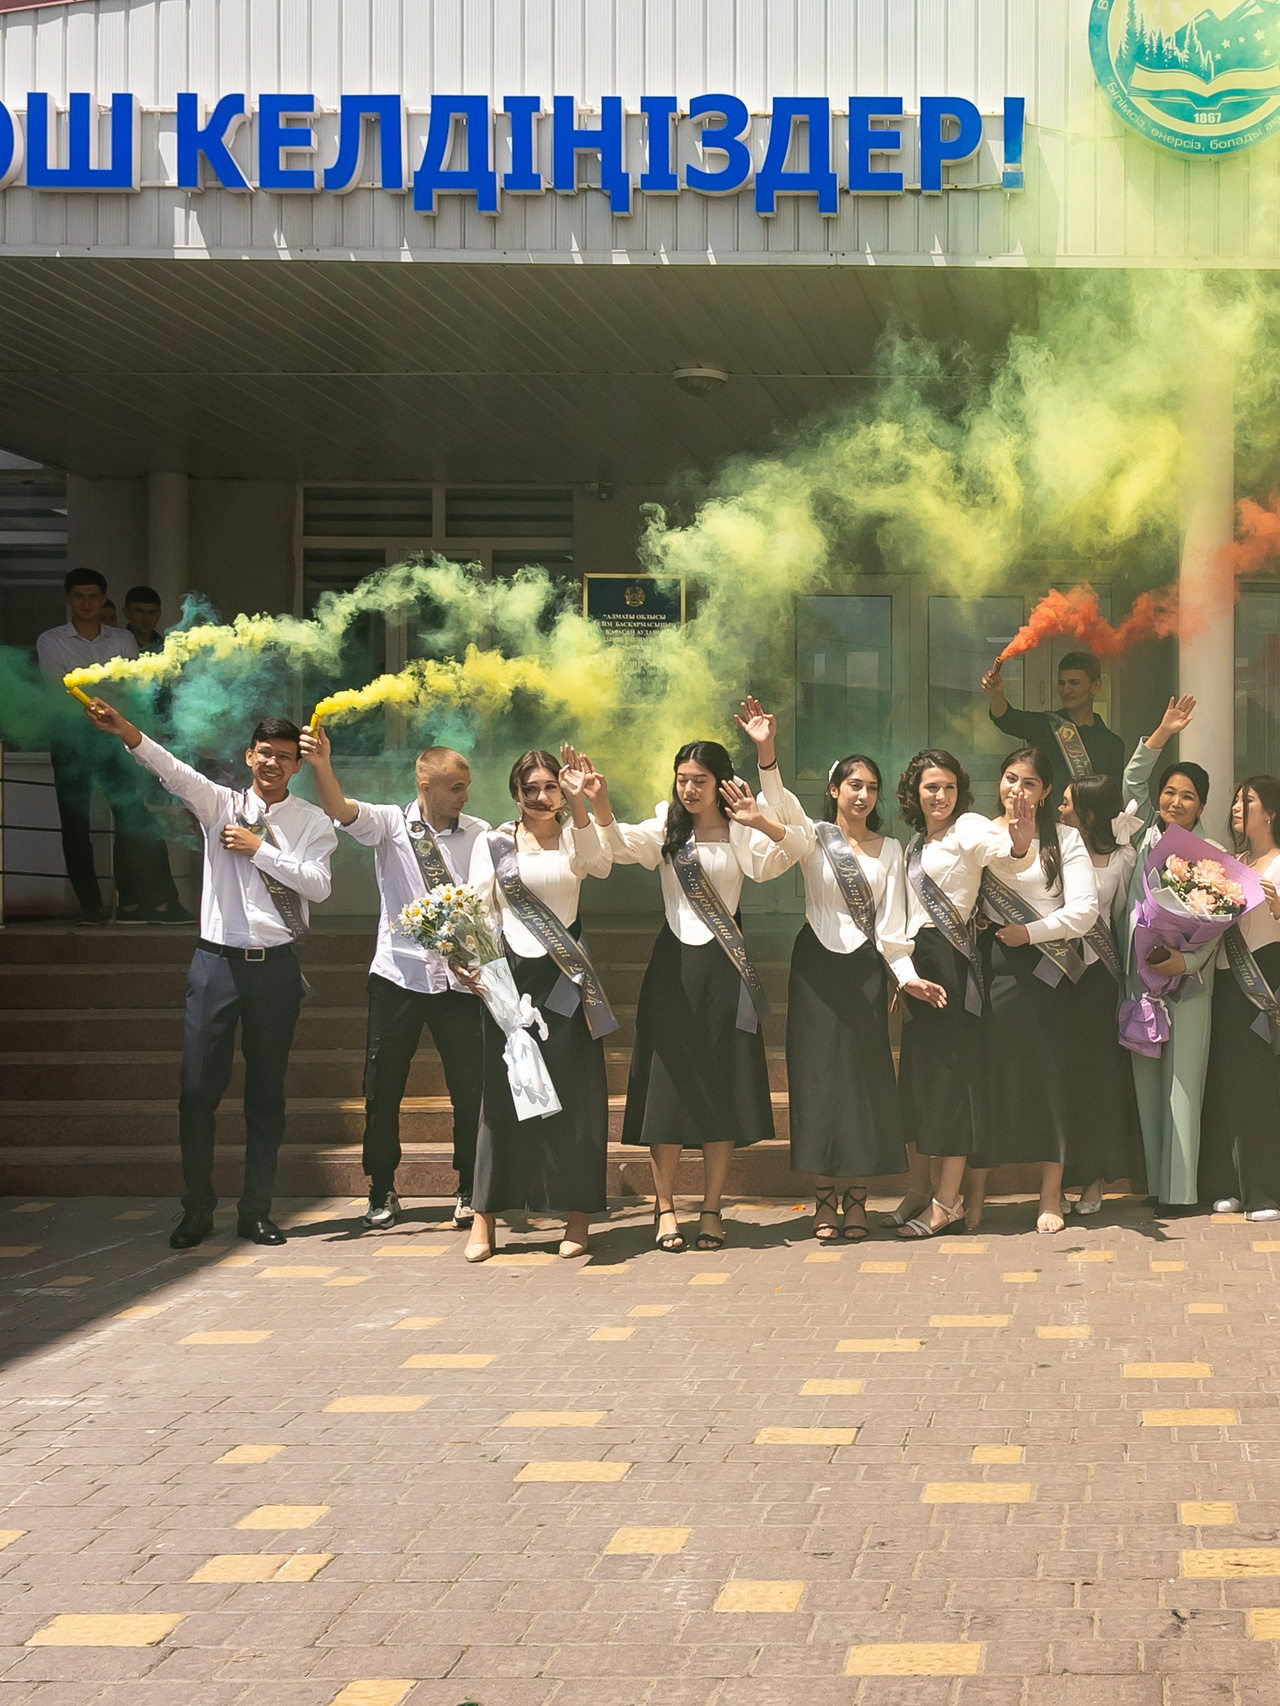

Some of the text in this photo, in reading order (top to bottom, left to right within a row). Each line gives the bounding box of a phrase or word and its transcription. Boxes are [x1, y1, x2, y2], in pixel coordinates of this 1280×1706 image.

[1193, 112, 1222, 124] 1867
[1209, 128, 1262, 150] болады
[0, 91, 1026, 218] Ш КЕЛДІҢІЗДЕР!
